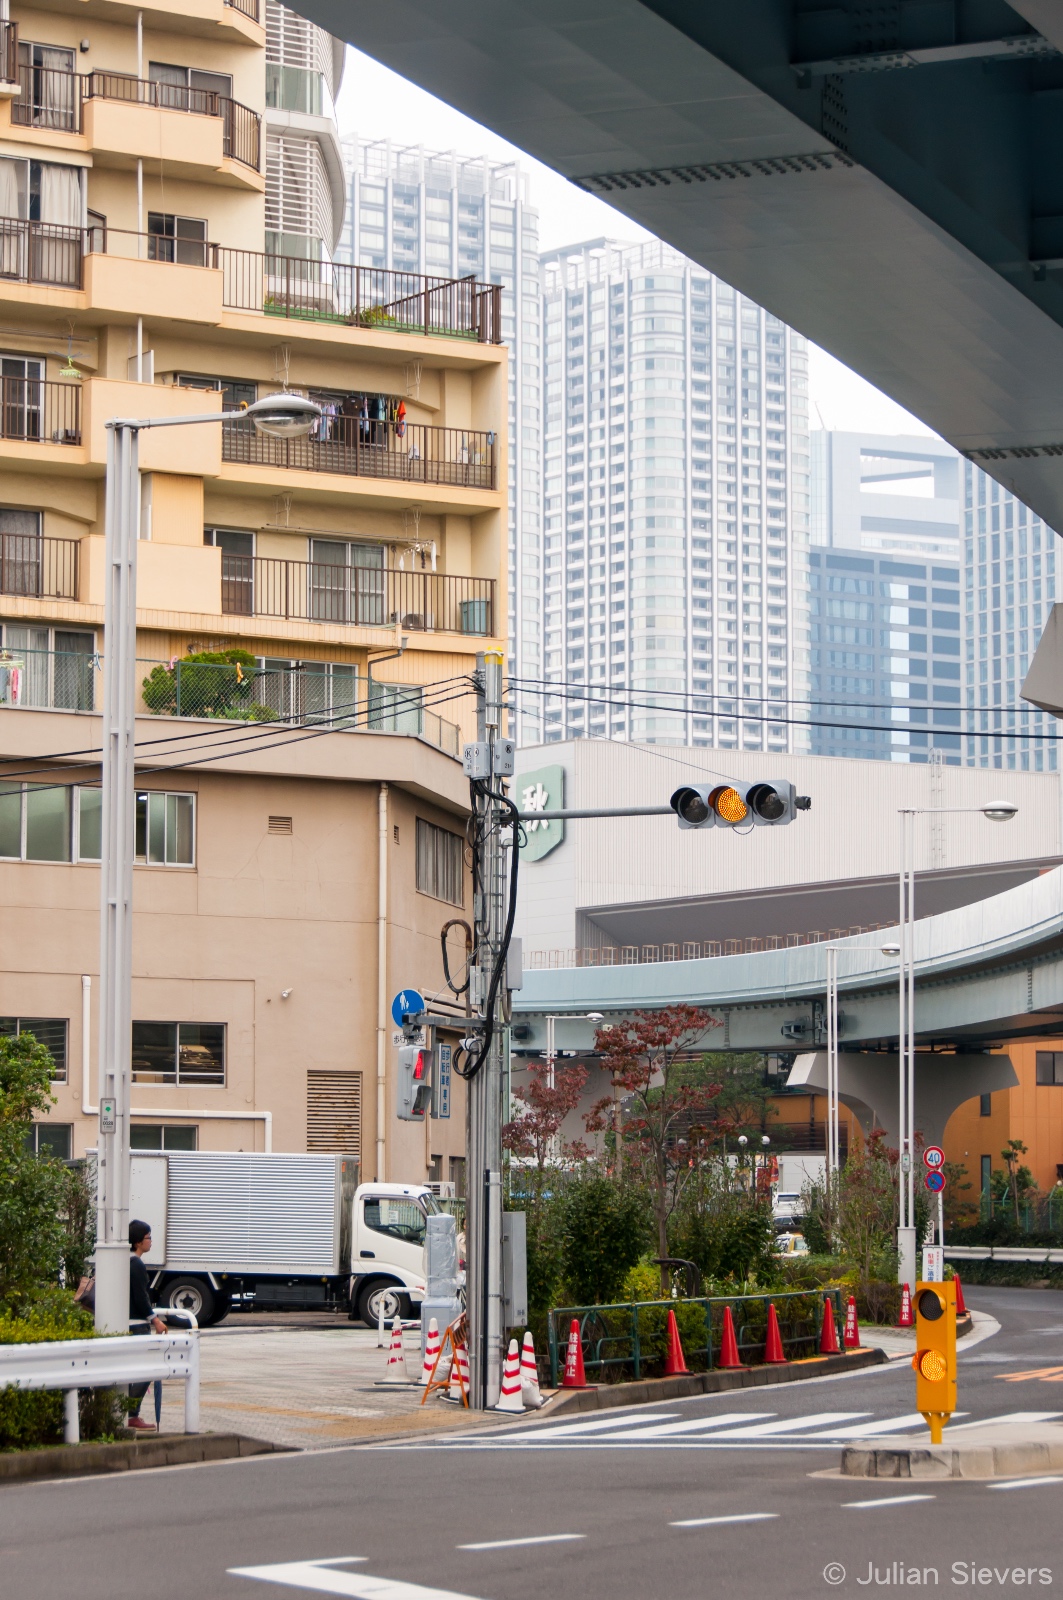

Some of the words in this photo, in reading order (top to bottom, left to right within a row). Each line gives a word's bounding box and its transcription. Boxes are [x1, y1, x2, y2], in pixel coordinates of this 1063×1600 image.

[522, 782, 549, 832] 秋
[928, 1152, 940, 1163] 40
[846, 1304, 855, 1338] 駐車禁止
[566, 1332, 578, 1376] 駐車禁止
